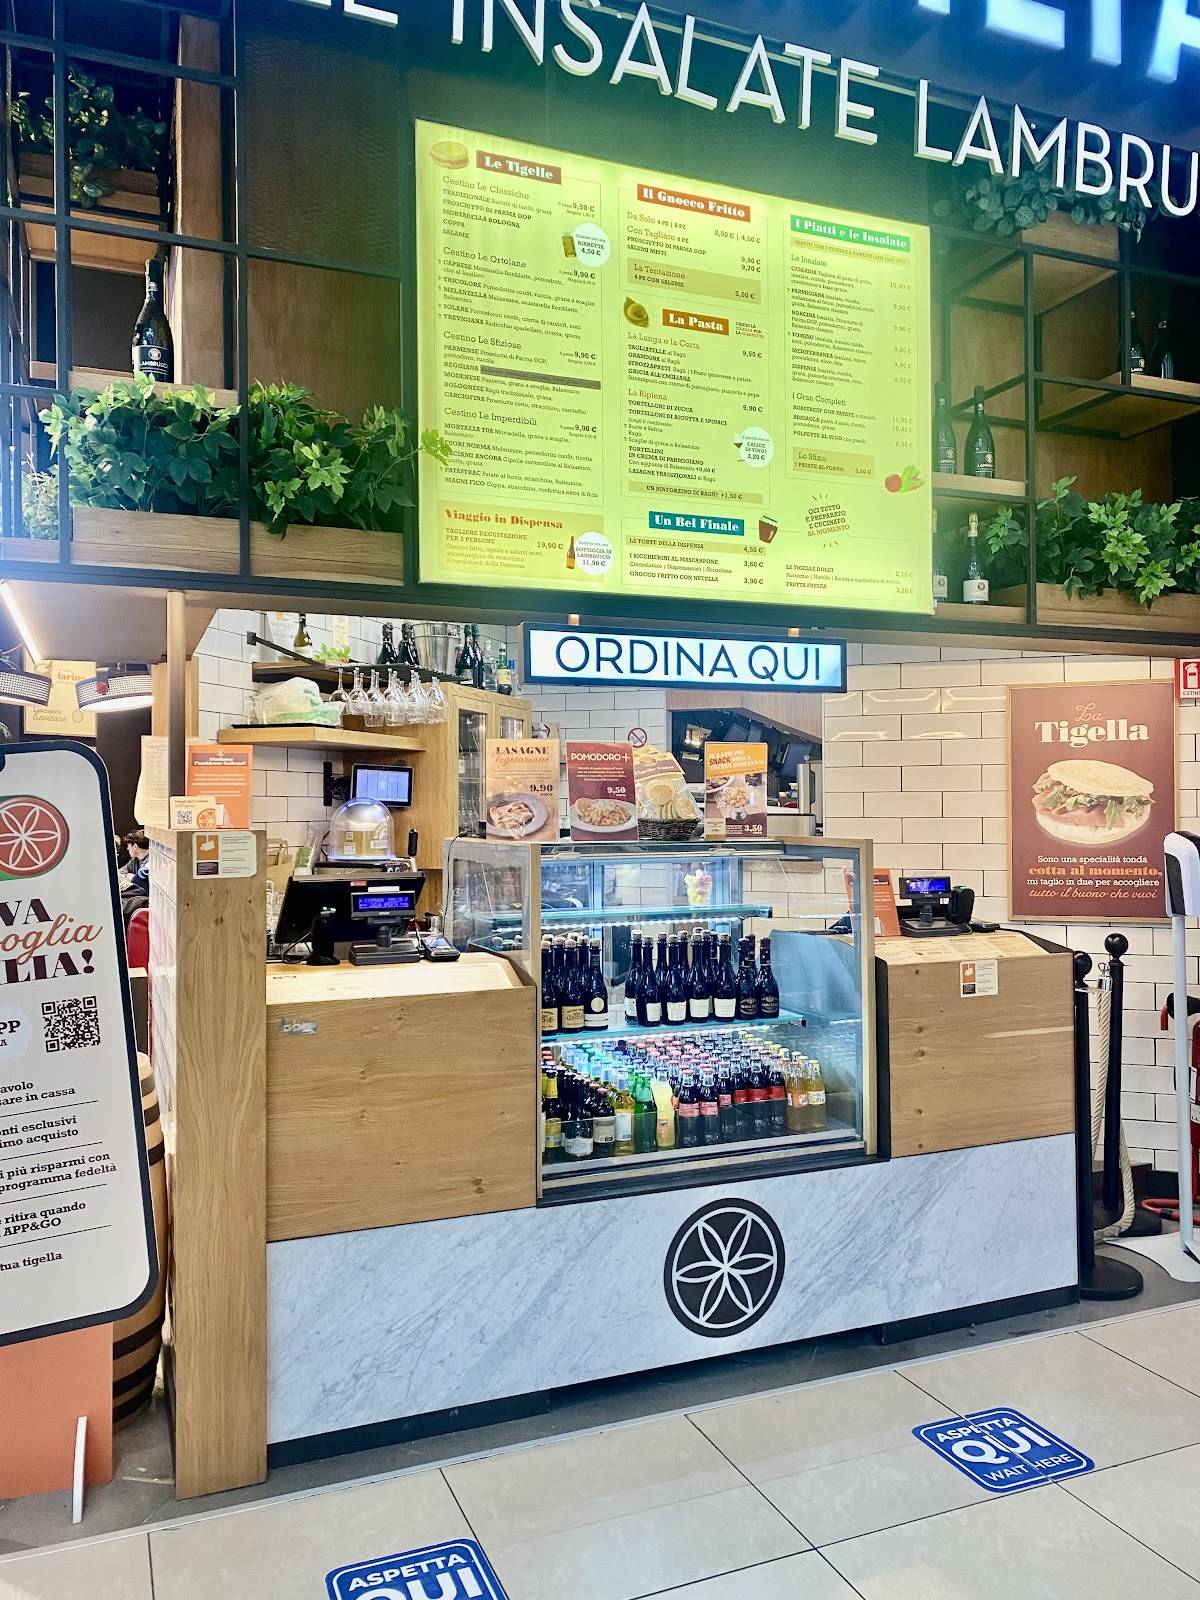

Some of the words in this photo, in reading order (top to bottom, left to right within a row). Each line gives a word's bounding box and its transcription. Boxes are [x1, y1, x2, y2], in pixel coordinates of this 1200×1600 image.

[914, 79, 1199, 216] LAMBRU
[484, 157, 502, 170] Le
[506, 159, 553, 180] Tigelle
[442, 176, 476, 190] Cestino
[478, 182, 488, 191] Le
[489, 185, 529, 200] Classiche
[443, 189, 491, 204] TRADIZIONALE
[643, 188, 653, 200] Il
[657, 191, 704, 210] Gnocco
[707, 200, 745, 219] Fritto
[443, 199, 484, 212] PROSCIUTTO
[494, 208, 516, 219] PARMA
[518, 213, 531, 221] DOP
[443, 209, 487, 223] MORTADELLA
[488, 218, 520, 229] BOLOGNA
[443, 219, 465, 229] COPPA
[443, 229, 469, 239] SALAME
[627, 225, 642, 236] Con
[644, 229, 675, 242] Tagliere
[795, 219, 800, 229] I
[804, 221, 836, 236] Piatti
[840, 230, 846, 238] e
[849, 230, 859, 240] le
[863, 232, 906, 248] Insalate
[578, 241, 604, 250] BIRRETTA
[581, 248, 595, 256] 4,50
[443, 247, 475, 260] Cestino
[478, 253, 488, 261] Le
[490, 256, 526, 269] Ortolane
[444, 260, 472, 270] CAPRESE
[802, 257, 827, 268] Insalate
[574, 270, 589, 279] 9,90
[634, 264, 643, 272] La
[645, 266, 685, 280] Tentazione
[444, 277, 482, 289] TRICOLORE
[444, 287, 487, 300] MELANZELLA
[444, 304, 469, 313] SOLARE
[444, 314, 484, 326] TREVIGIANA
[669, 313, 685, 325] La
[688, 316, 723, 332] Pasta
[444, 331, 476, 343] Cestino
[478, 337, 488, 345] Le
[490, 338, 521, 350] Sfiziose
[628, 332, 637, 340] La
[639, 333, 661, 345] Lunga
[670, 338, 677, 346] la
[680, 339, 700, 350] Corta
[444, 345, 479, 355] PARMENSE
[574, 351, 589, 360] 9,90
[628, 345, 666, 356] TAGLIATELLE
[628, 353, 660, 362] GRAMIGNA
[444, 362, 478, 372] REGGIANA
[628, 361, 670, 372] STROZZAPRETI
[444, 372, 480, 382] MODENESE
[444, 382, 484, 392] BOLOGNESE
[444, 392, 485, 402] CARCIOFINA
[628, 389, 637, 398] La
[639, 390, 667, 402] Ripiena
[796, 393, 813, 402] Gran
[816, 396, 845, 407] Completi
[444, 408, 476, 420] Cestino
[479, 412, 489, 420] Le
[491, 413, 537, 426] Imperdibili
[575, 425, 590, 433] 9,90
[445, 509, 490, 524] Viaggio
[495, 514, 506, 525] in
[511, 516, 562, 530] Dispensa
[654, 515, 672, 526] Un
[676, 517, 696, 529] Bel
[699, 518, 739, 533] Finale
[537, 541, 556, 550] 19,90
[744, 546, 757, 554] 4,50
[555, 636, 738, 677] ORDINA
[748, 644, 820, 681] QUI
[1074, 703, 1103, 721] La
[1035, 719, 1149, 748] Tigella
[496, 747, 549, 755] LASAGNE
[744, 824, 762, 832] 3,50
[1079, 855, 1121, 864] specialità
[1029, 867, 1066, 876] cotta
[1071, 866, 1085, 875] al
[1040, 878, 1064, 887] taglio
[1113, 879, 1159, 887] accogliere
[1030, 888, 1058, 897] tutto
[1061, 888, 1071, 897] il
[1072, 888, 1108, 898] buono
[1110, 890, 1129, 898] che
[1131, 890, 1157, 899] vuoi
[26, 1094, 38, 1102] in
[41, 1087, 75, 1099] cassa
[22, 1115, 77, 1133] esclusivi
[26, 1129, 78, 1144] acquisto
[7, 1167, 27, 1181] più
[30, 1156, 86, 1174] risparmi
[88, 1153, 110, 1163] con
[0, 1173, 72, 1194] programma
[75, 1163, 117, 1178] fedeltà
[5, 1210, 37, 1224] ritira
[40, 1201, 86, 1218] quando
[3, 1217, 62, 1237] APP&GO
[0, 1261, 20, 1271] tua
[22, 1252, 63, 1268] tigella
[935, 1418, 1019, 1442] ASPETTA
[951, 1426, 1051, 1465] QUI
[984, 1465, 1028, 1481] WAIT
[1035, 1454, 1076, 1470] HERE
[349, 1554, 467, 1591] ASPETTA
